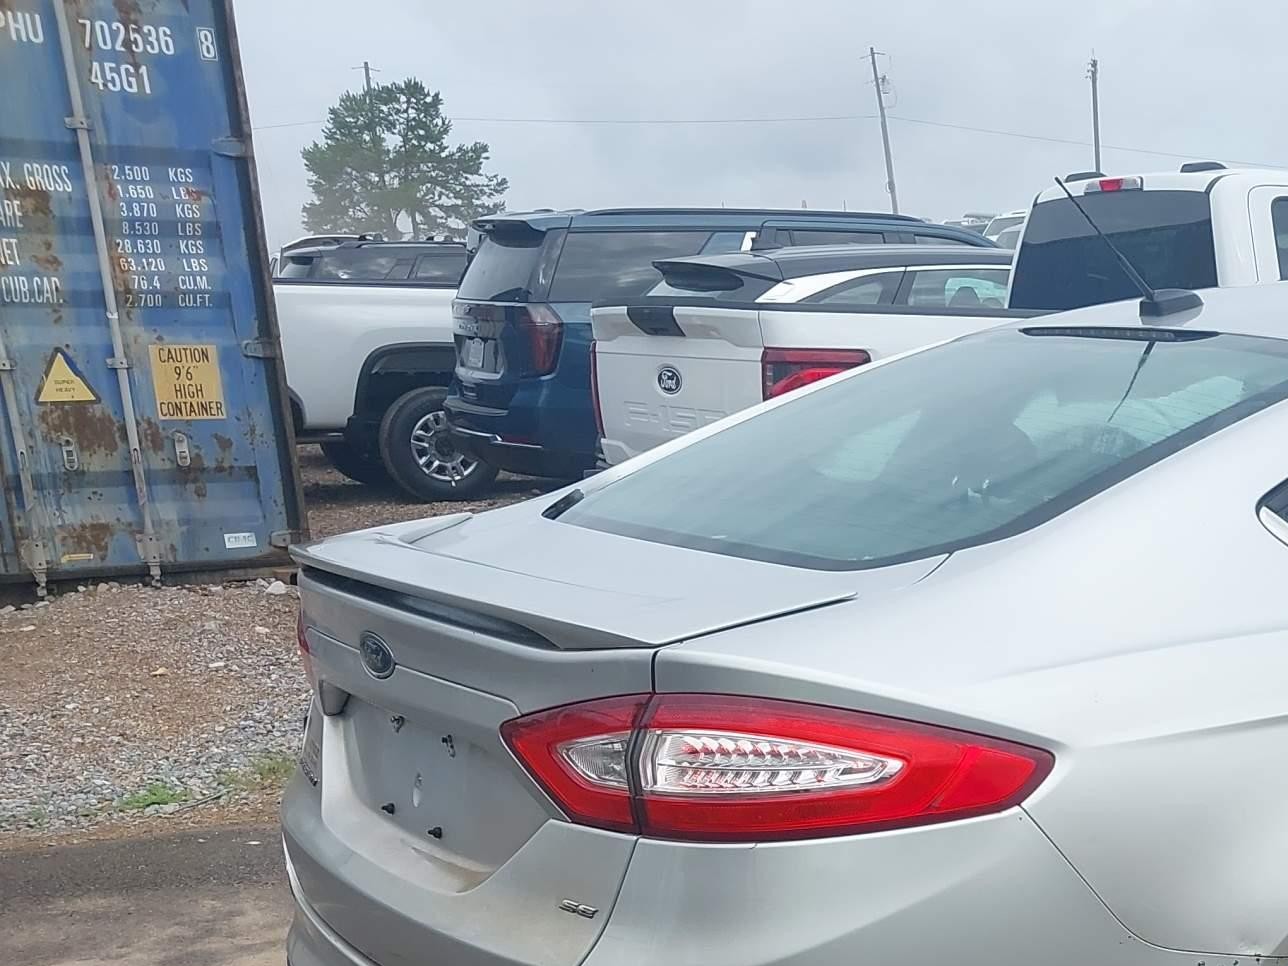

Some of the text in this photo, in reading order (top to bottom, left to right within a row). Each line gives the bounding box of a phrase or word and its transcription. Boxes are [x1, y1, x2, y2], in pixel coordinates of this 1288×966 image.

[78, 19, 175, 55] 702536
[91, 61, 151, 94] 45G1
[23, 162, 73, 192] GROSS
[168, 167, 193, 182] KGS
[120, 203, 201, 218] 3.870 KGS
[122, 222, 202, 236] 8.530 LBS
[116, 239, 204, 254] 28.630 KGS
[119, 257, 208, 272] 63.120 LBS
[131, 275, 212, 290] 76.4 CU.M.
[126, 293, 213, 307] 2.700 CU.FT.
[158, 346, 210, 364] CAUTION
[173, 383, 205, 400] HIGH
[159, 400, 225, 418] CONTAINER
[558, 899, 599, 919] SE
